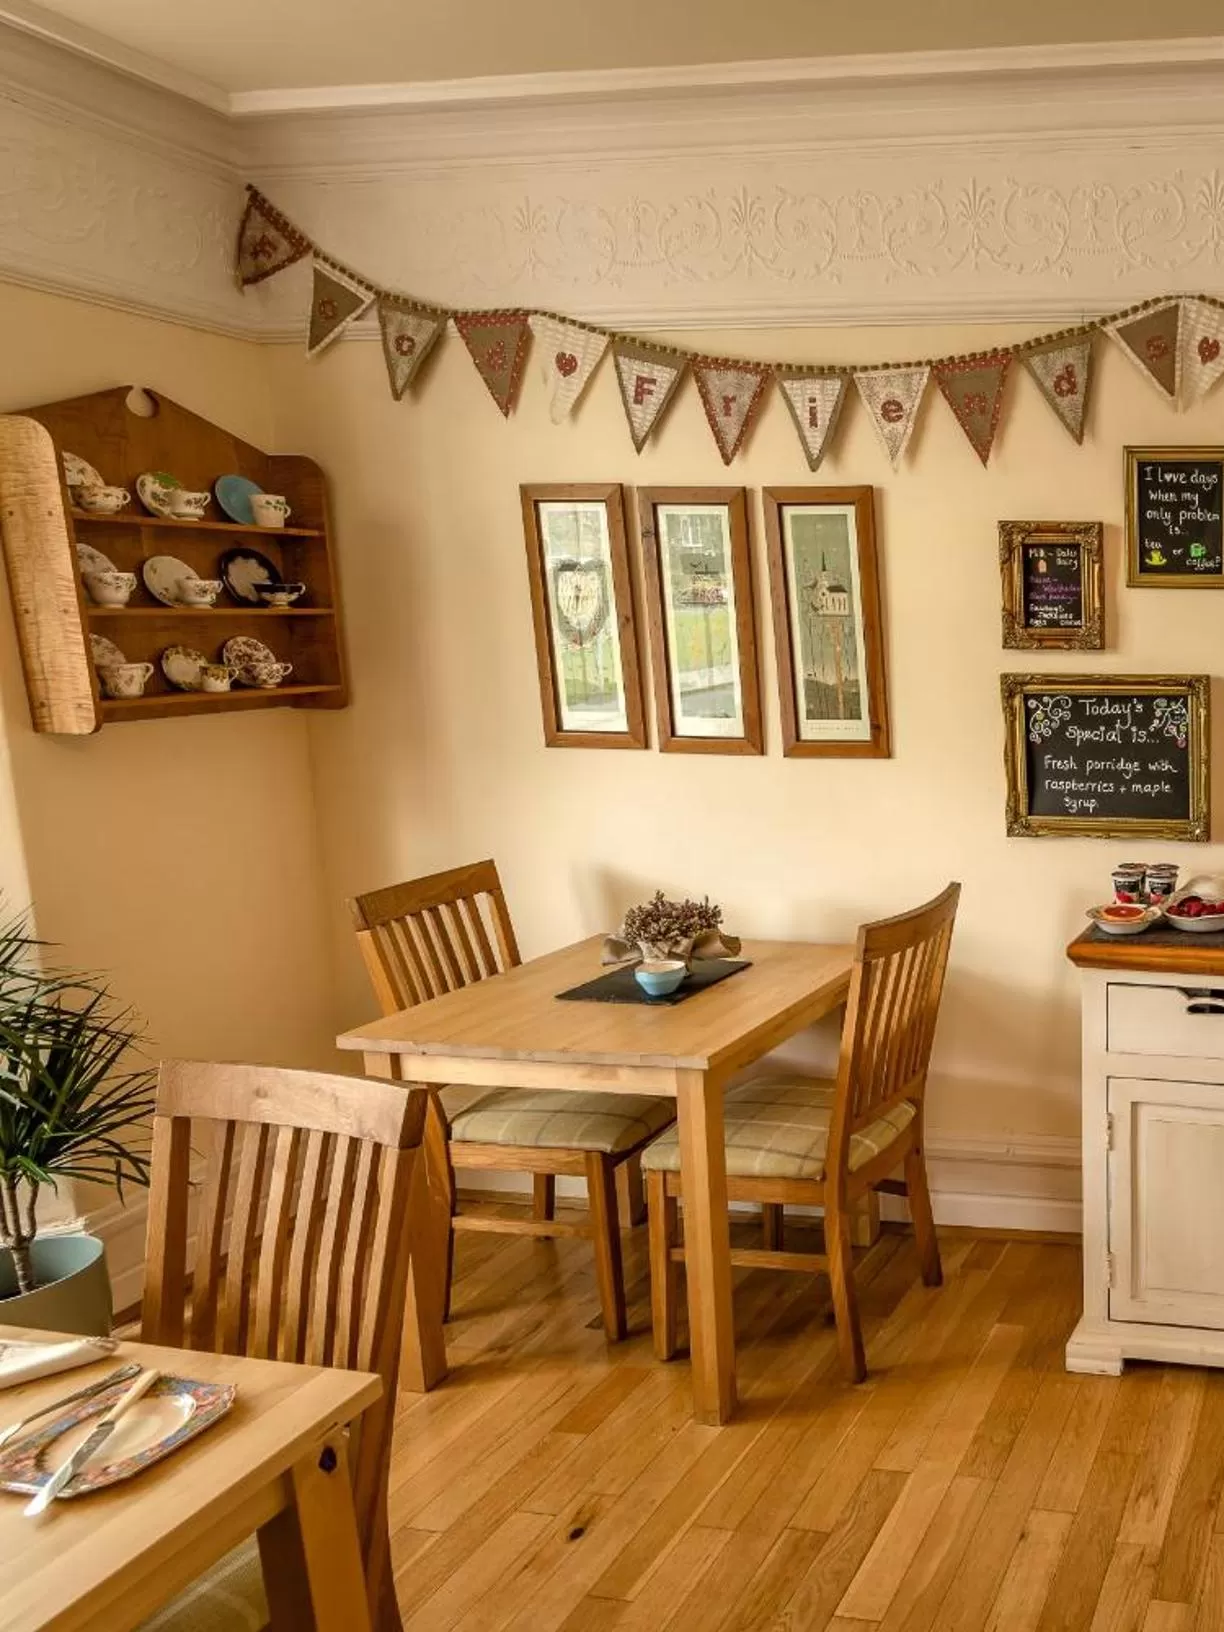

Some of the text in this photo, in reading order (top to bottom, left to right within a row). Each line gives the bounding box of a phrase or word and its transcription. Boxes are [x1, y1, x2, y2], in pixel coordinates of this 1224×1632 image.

[1143, 466, 1153, 481] I
[1190, 468, 1218, 491] days
[1181, 491, 1199, 509] my
[1146, 507, 1220, 526] only problem
[1145, 538, 1162, 549] tea
[1078, 698, 1143, 729] Today's
[1066, 720, 1122, 747] Special
[1044, 754, 1179, 779] Fresh porridge with
[1045, 779, 1114, 793] raspberries
[1131, 781, 1172, 797] maple
